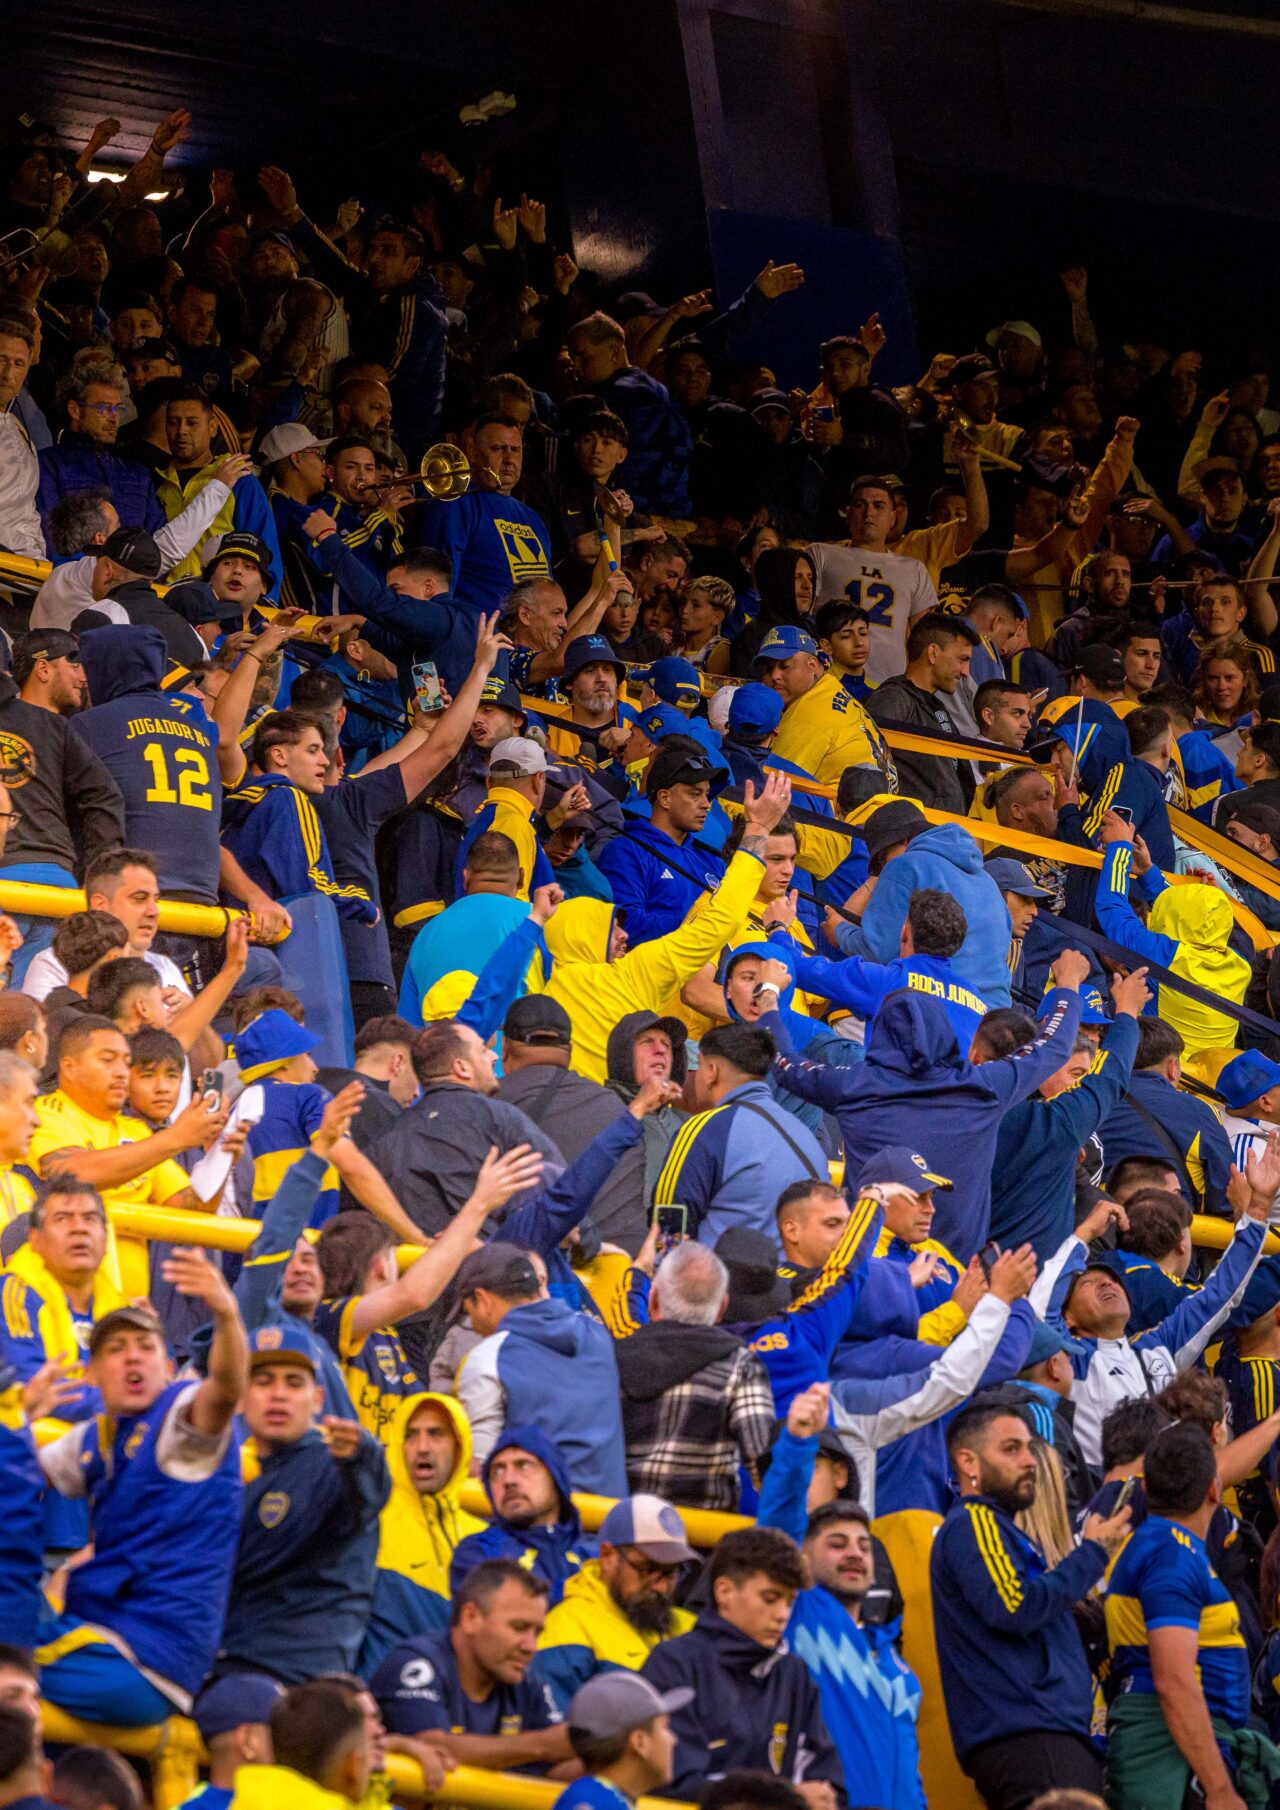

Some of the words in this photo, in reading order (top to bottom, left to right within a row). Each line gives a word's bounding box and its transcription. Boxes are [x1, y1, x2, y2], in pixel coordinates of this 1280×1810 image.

[499, 522, 534, 537] adidas
[861, 566, 883, 579] LA
[844, 580, 895, 627] 12
[126, 718, 192, 740] JUGADOR
[143, 743, 213, 811] 12
[908, 972, 945, 999] BOCA
